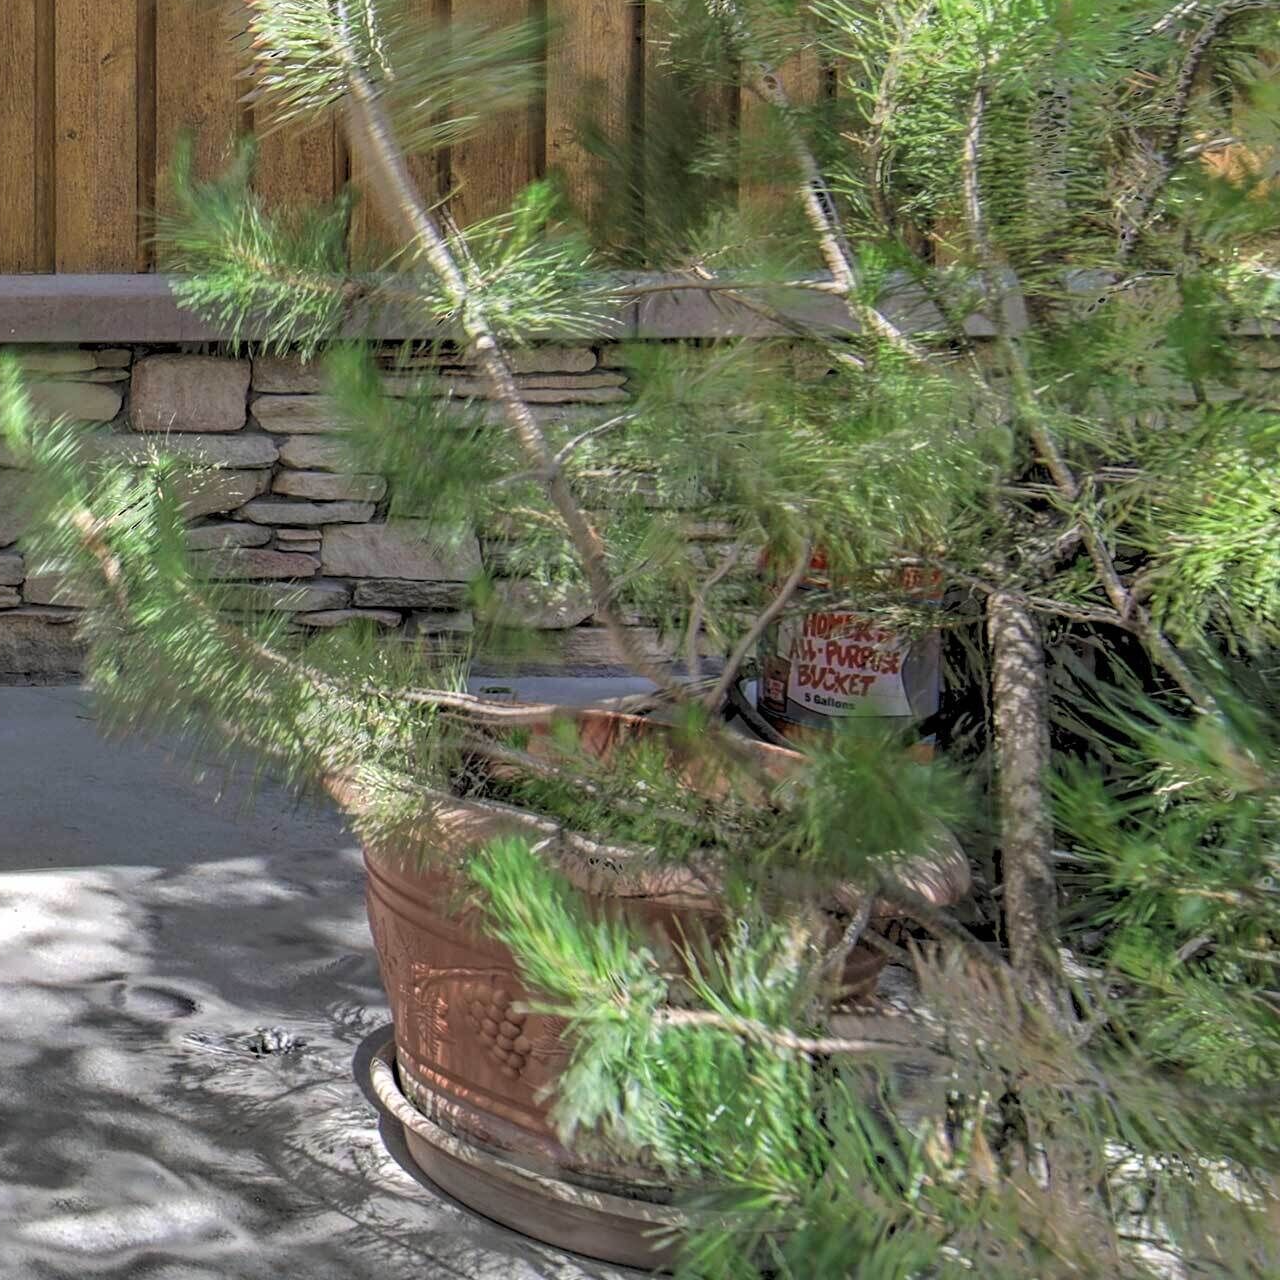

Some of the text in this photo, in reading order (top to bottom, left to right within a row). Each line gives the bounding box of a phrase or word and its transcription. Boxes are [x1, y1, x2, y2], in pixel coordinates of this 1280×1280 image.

[798, 664, 876, 696] BUCKET
[804, 692, 857, 710] 5 Gallons
